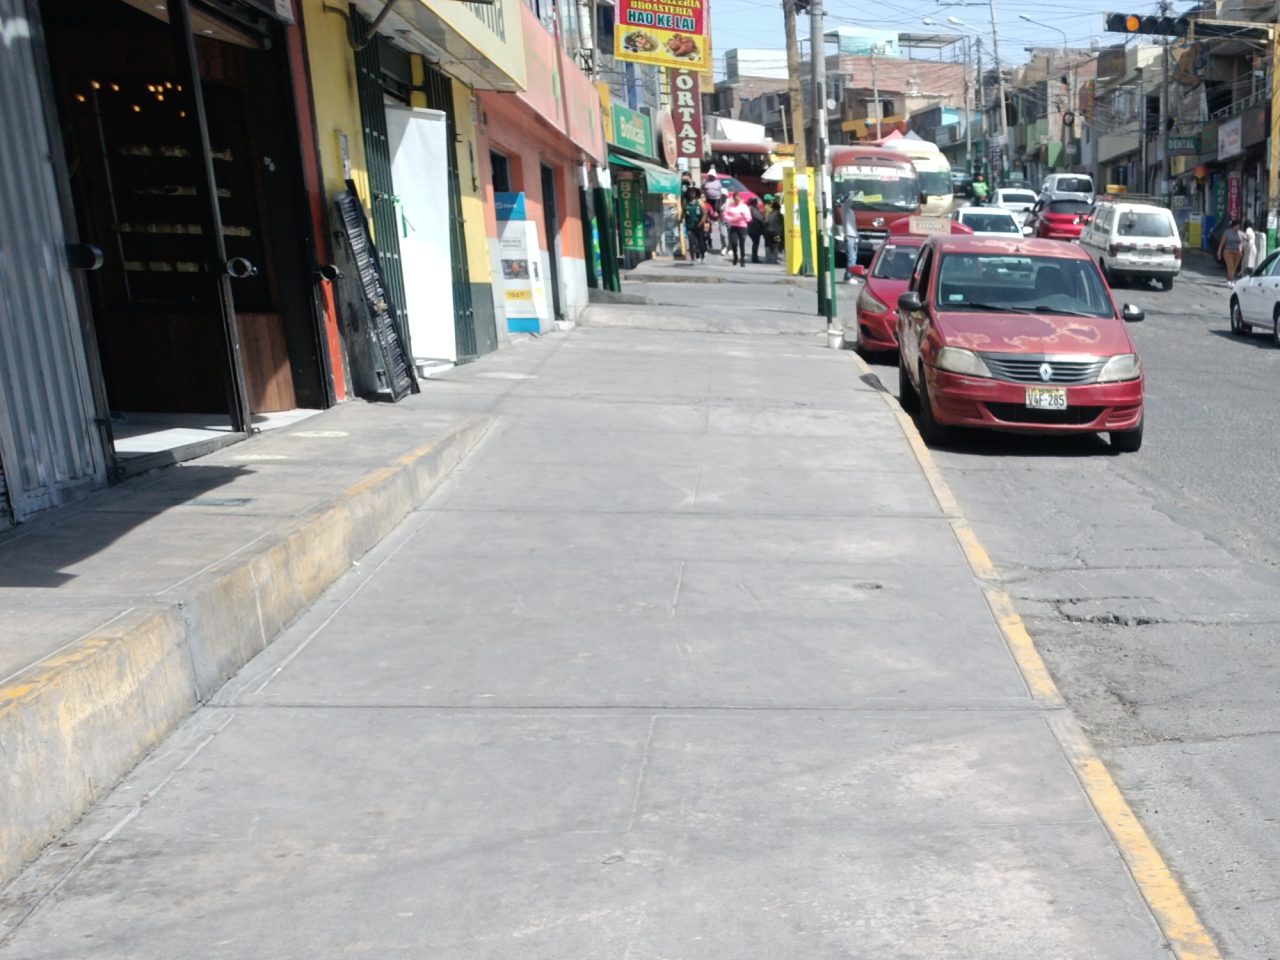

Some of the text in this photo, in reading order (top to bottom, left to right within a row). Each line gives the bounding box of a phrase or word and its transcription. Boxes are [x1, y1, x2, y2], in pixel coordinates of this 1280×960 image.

[630, 1, 694, 16] BROASTERIA
[627, 9, 696, 31] HAO KE LAI
[675, 68, 698, 154] ORTAS
[1028, 393, 1065, 406] V4F-285
